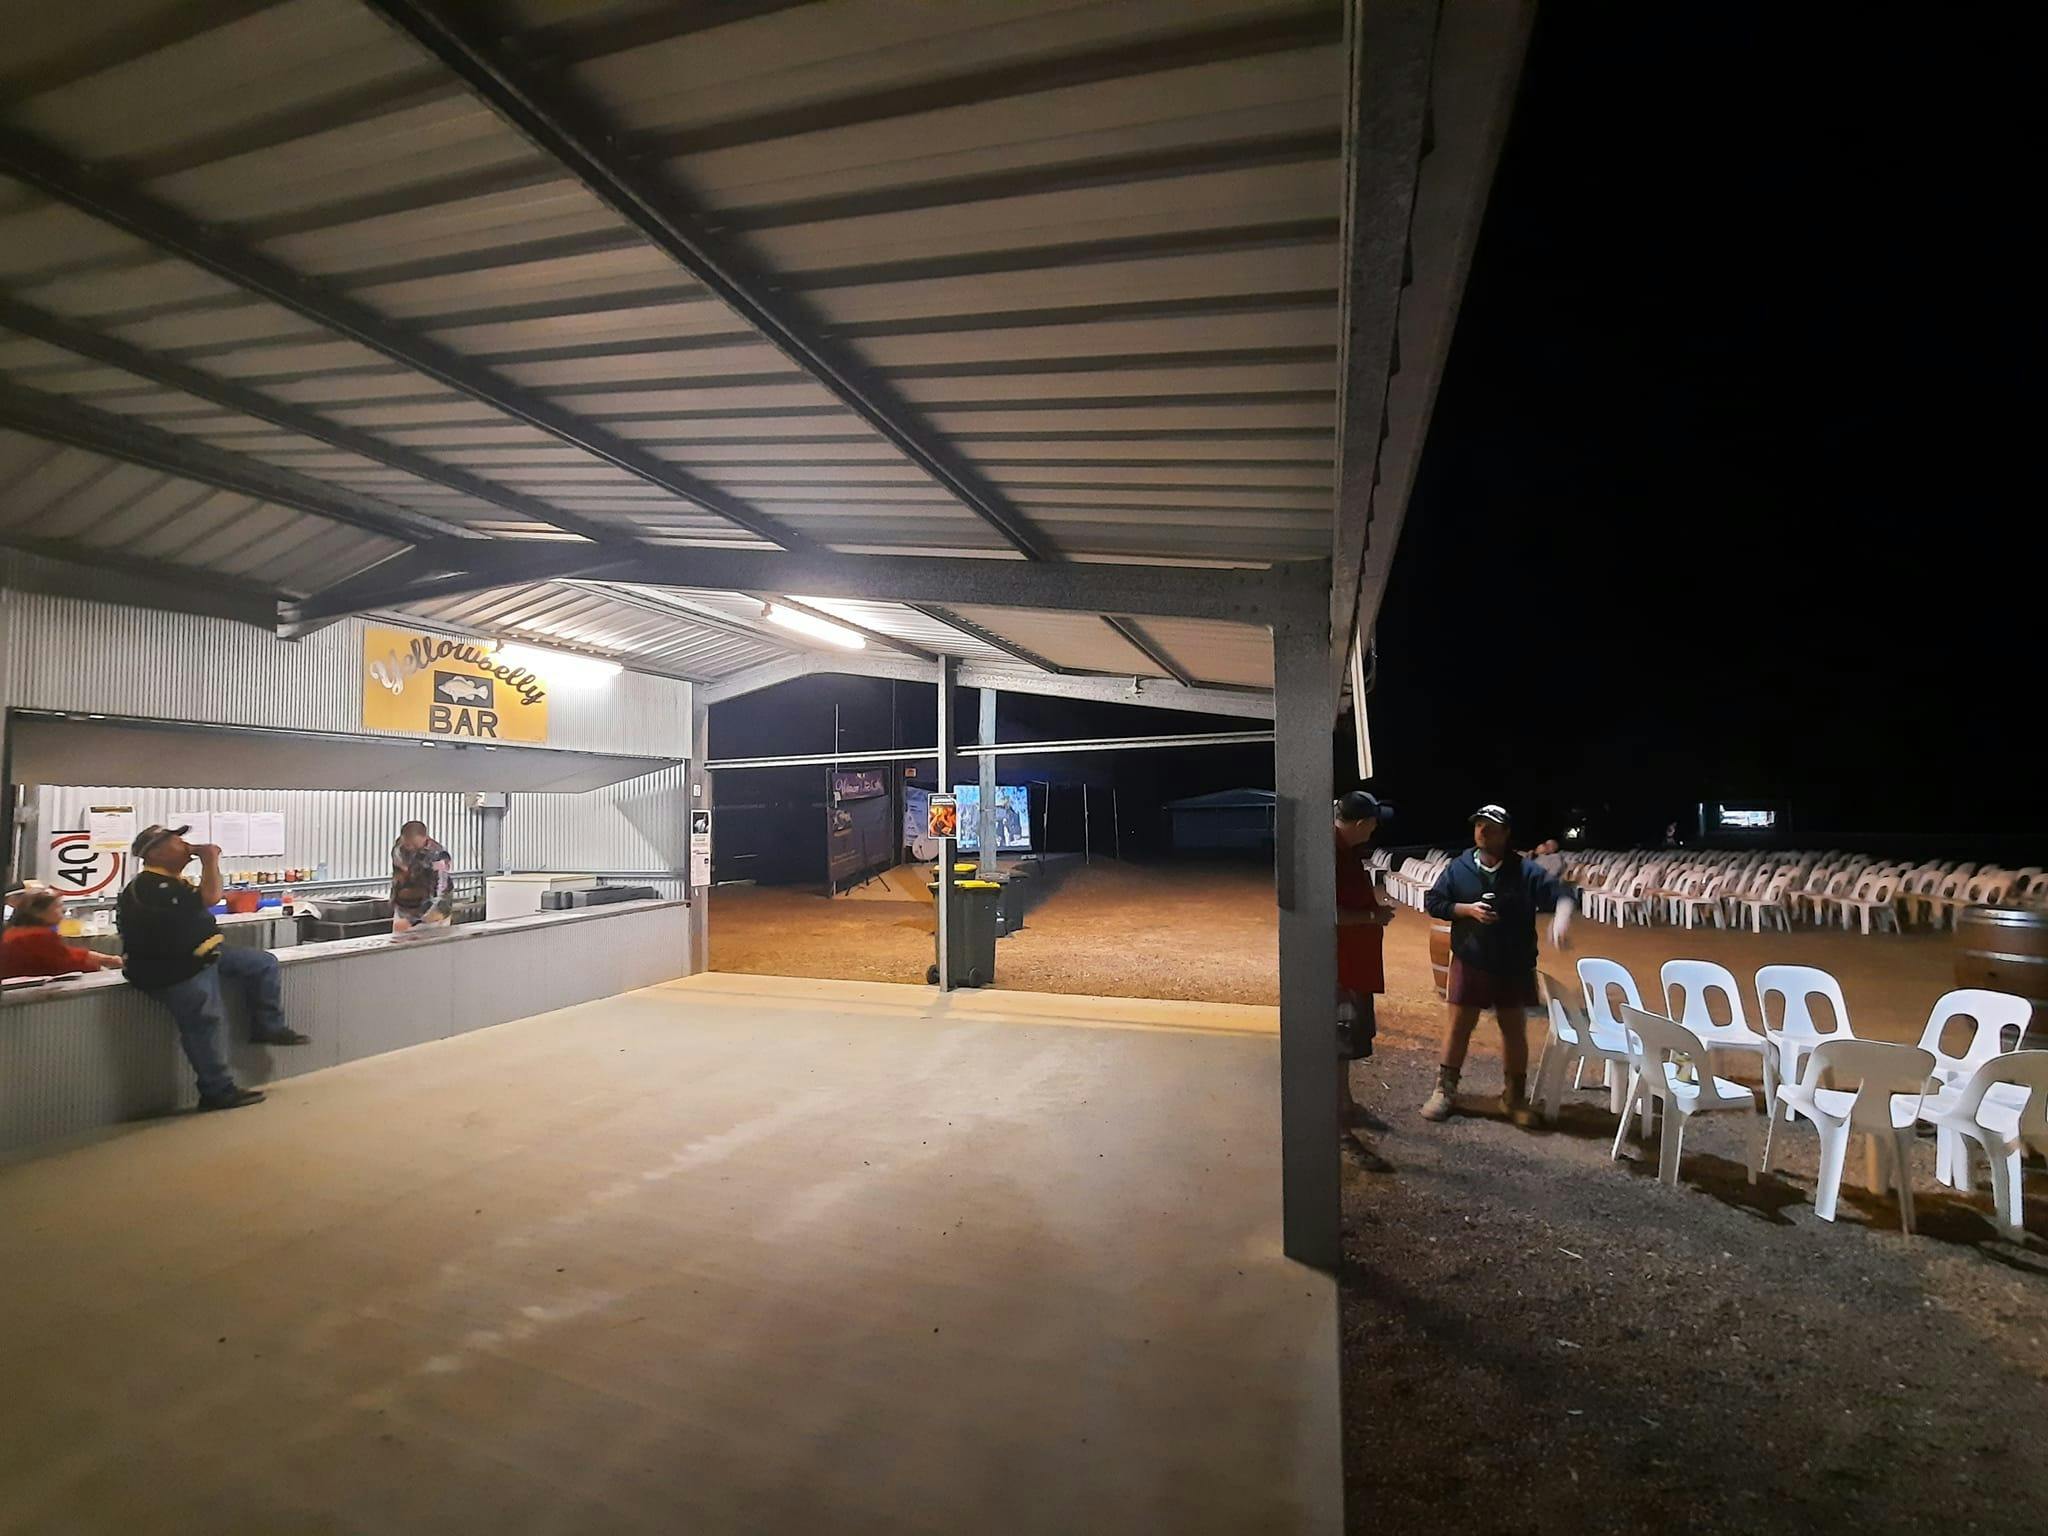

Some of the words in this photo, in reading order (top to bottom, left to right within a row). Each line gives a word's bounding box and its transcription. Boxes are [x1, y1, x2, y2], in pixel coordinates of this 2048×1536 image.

[370, 636, 546, 705] Yellowbelly
[428, 704, 499, 738] BAR
[57, 844, 99, 887] 40
